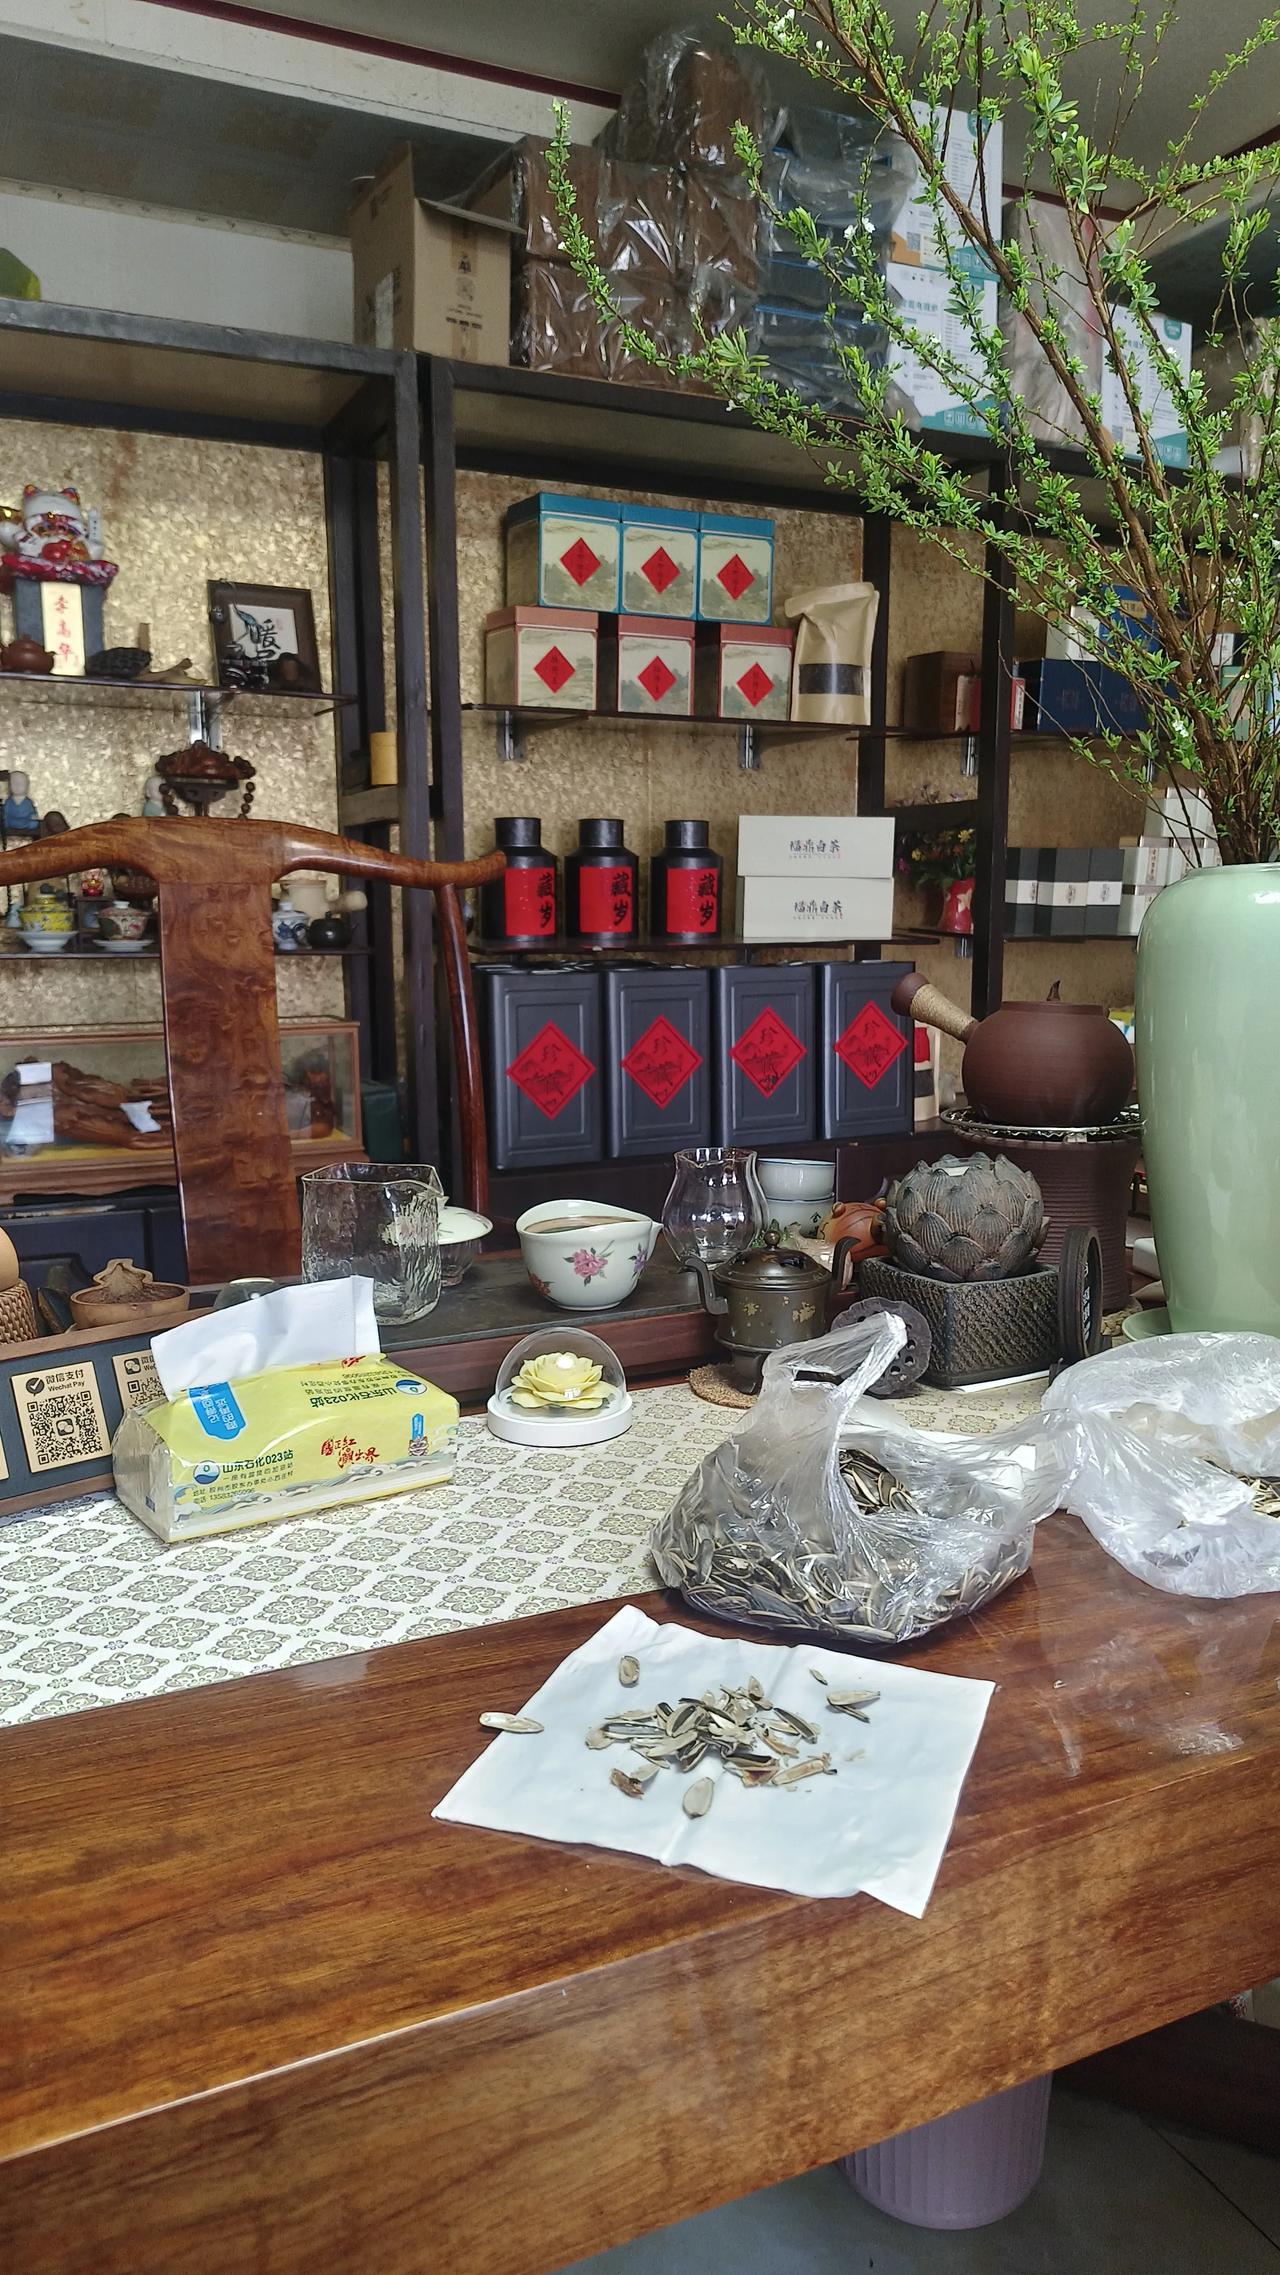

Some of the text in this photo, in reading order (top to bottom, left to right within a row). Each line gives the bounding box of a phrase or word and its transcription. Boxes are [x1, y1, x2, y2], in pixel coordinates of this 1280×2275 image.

[45, 1368, 84, 1386] 微信支付
[73, 1380, 85, 1388] Pay
[309, 1387, 397, 1408] 山东石化023站
[222, 1449, 294, 1474] 山东石化023站
